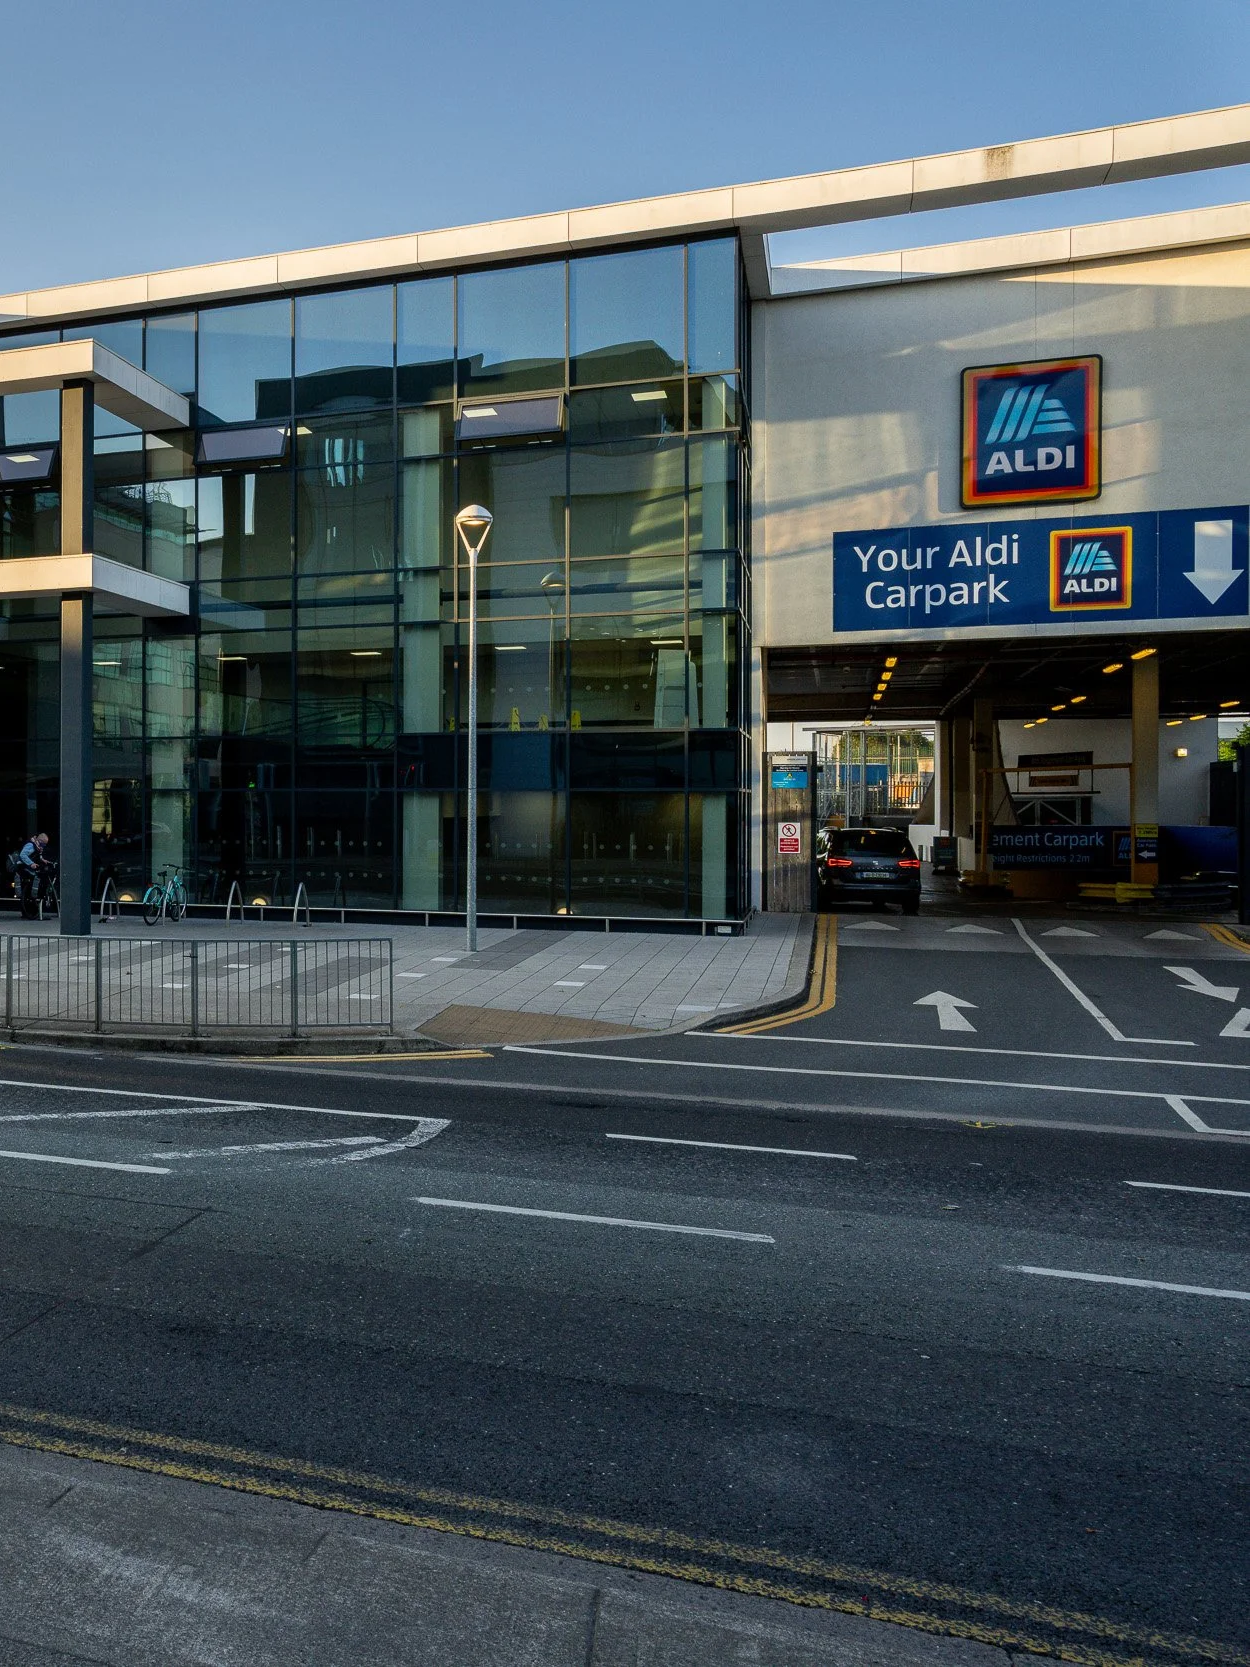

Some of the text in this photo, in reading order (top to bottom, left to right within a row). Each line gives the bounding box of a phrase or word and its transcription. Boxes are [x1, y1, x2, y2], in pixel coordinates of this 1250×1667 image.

[985, 445, 1075, 475] ALDI
[853, 534, 1019, 573] Your Aldi
[865, 574, 1010, 613] Carpark
[1063, 577, 1117, 594] ALDI
[992, 831, 1105, 850] ement Carpark
[992, 853, 1014, 864] eight
[1016, 853, 1066, 863] Restrictions
